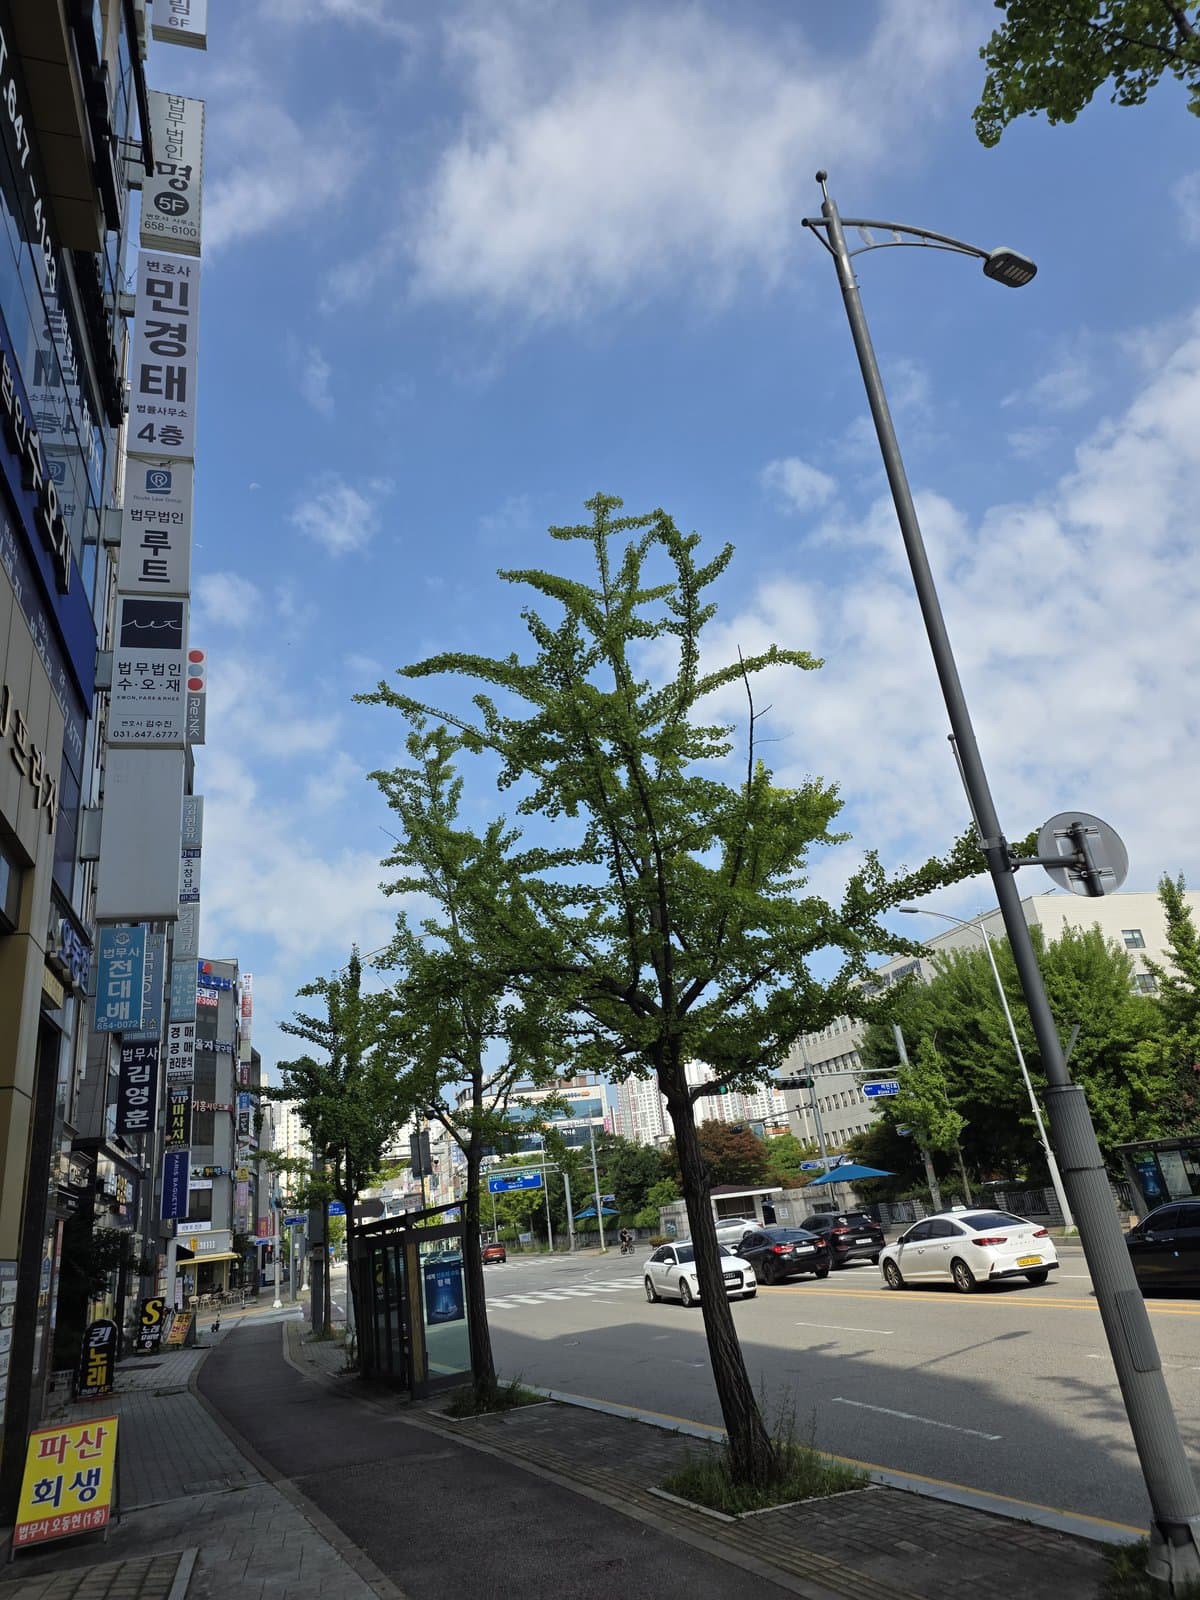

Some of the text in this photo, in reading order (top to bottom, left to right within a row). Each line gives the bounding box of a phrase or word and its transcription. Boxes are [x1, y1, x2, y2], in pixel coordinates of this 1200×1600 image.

[168, 16, 191, 28] 6F
[164, 94, 186, 161] 법무법인
[155, 160, 192, 191] 명
[157, 197, 187, 212] 5F
[143, 220, 198, 237] 658-6100
[146, 259, 191, 278] 변호사
[139, 277, 190, 403] 민경태
[136, 403, 188, 418] 법률사무소
[136, 422, 185, 447] 4층
[130, 508, 184, 525] 법무법인
[138, 529, 171, 583] 루트
[117, 661, 182, 678] 법무법인
[113, 729, 179, 739] 031.647.6777
[103, 946, 141, 959] 법무사
[122, 1047, 158, 1063] 법무사
[124, 1064, 150, 1129] 김영훈
[170, 1095, 189, 1104] VIP
[171, 1104, 186, 1142] 마사지
[144, 1300, 163, 1325] S
[89, 1326, 111, 1347] 퀸
[86, 1347, 108, 1387] 노래
[37, 1426, 108, 1465] 파산
[31, 1466, 102, 1508] 회생
[18, 1508, 105, 1541] 법무사 오동현 (1층)
